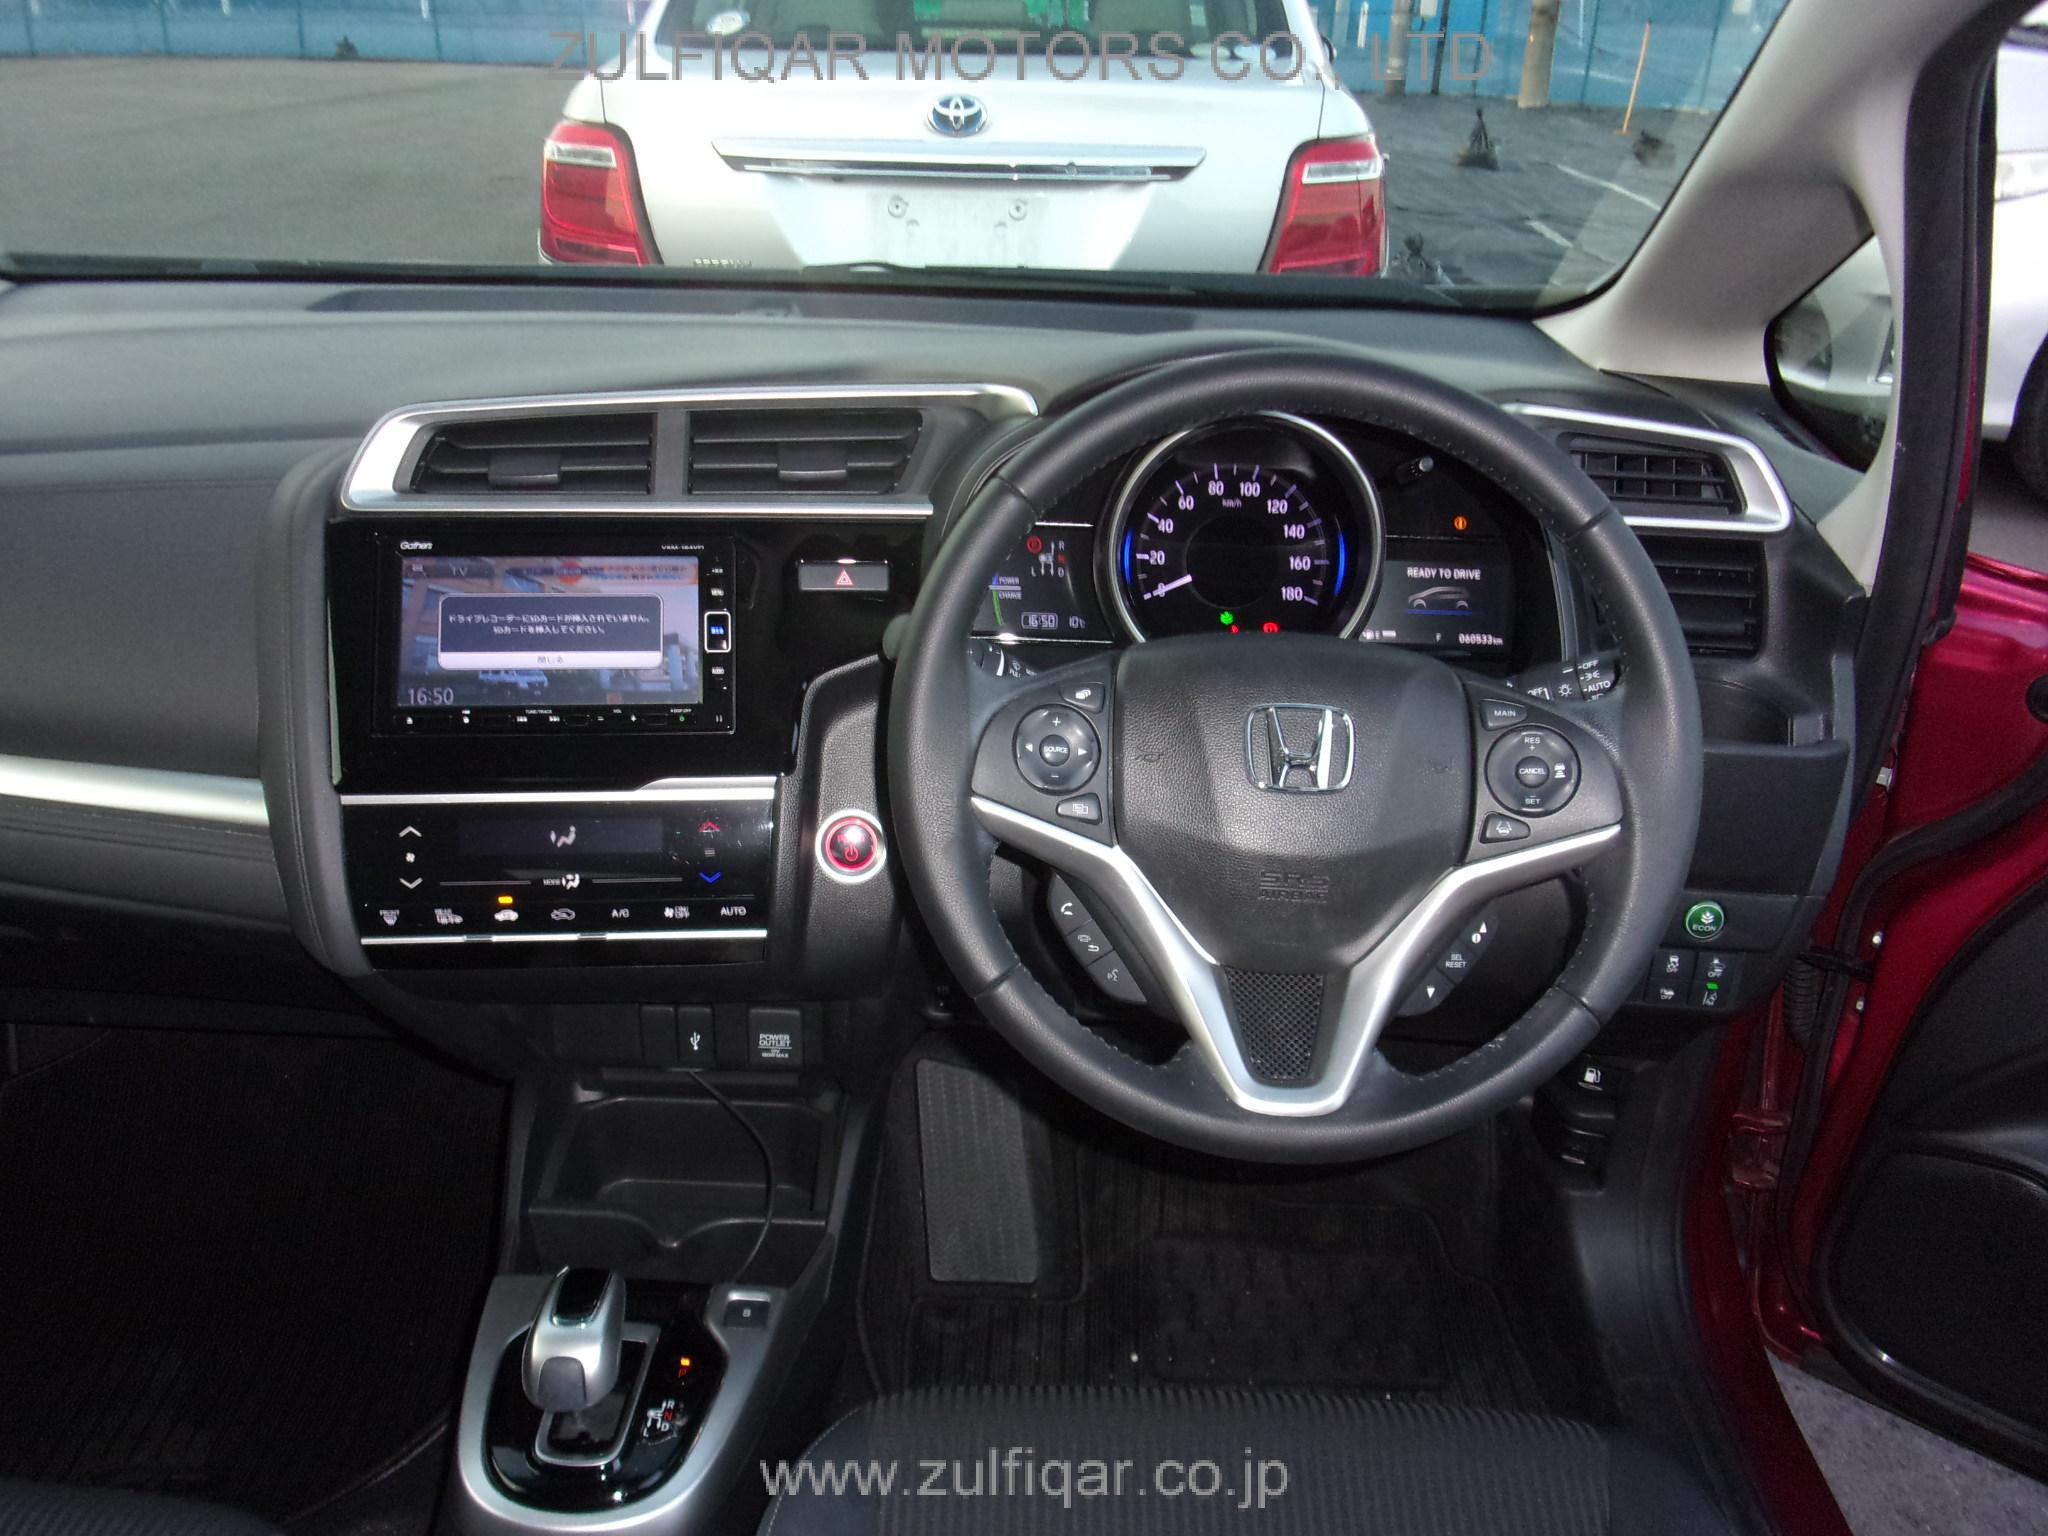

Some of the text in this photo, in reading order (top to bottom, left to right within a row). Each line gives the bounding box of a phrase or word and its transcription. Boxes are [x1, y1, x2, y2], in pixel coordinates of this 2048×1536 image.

[1208, 480, 1224, 496] 80
[1239, 481, 1261, 497] 100
[1178, 495, 1194, 510] 60
[1267, 499, 1288, 514] 120
[1157, 518, 1174, 534] 40
[1283, 523, 1305, 539] 140
[1149, 551, 1165, 566] 20
[1289, 556, 1311, 571] 160
[1406, 566, 1481, 581] READY TO DRIVE
[1281, 586, 1303, 602] 180
[1582, 660, 1600, 670] OFF
[1588, 680, 1612, 693] AUTO
[407, 686, 455, 705] 16:50
[1524, 736, 1541, 744] RES
[1043, 745, 1069, 754] SOURCE
[1519, 767, 1546, 775] CANCEL
[611, 908, 630, 918] A/C
[720, 906, 746, 917] AUTO
[1692, 923, 1716, 932] ECON
[759, 1033, 790, 1041] POWER
[667, 1400, 675, 1409] R
[664, 1411, 673, 1420] N
[661, 1423, 669, 1432] D
